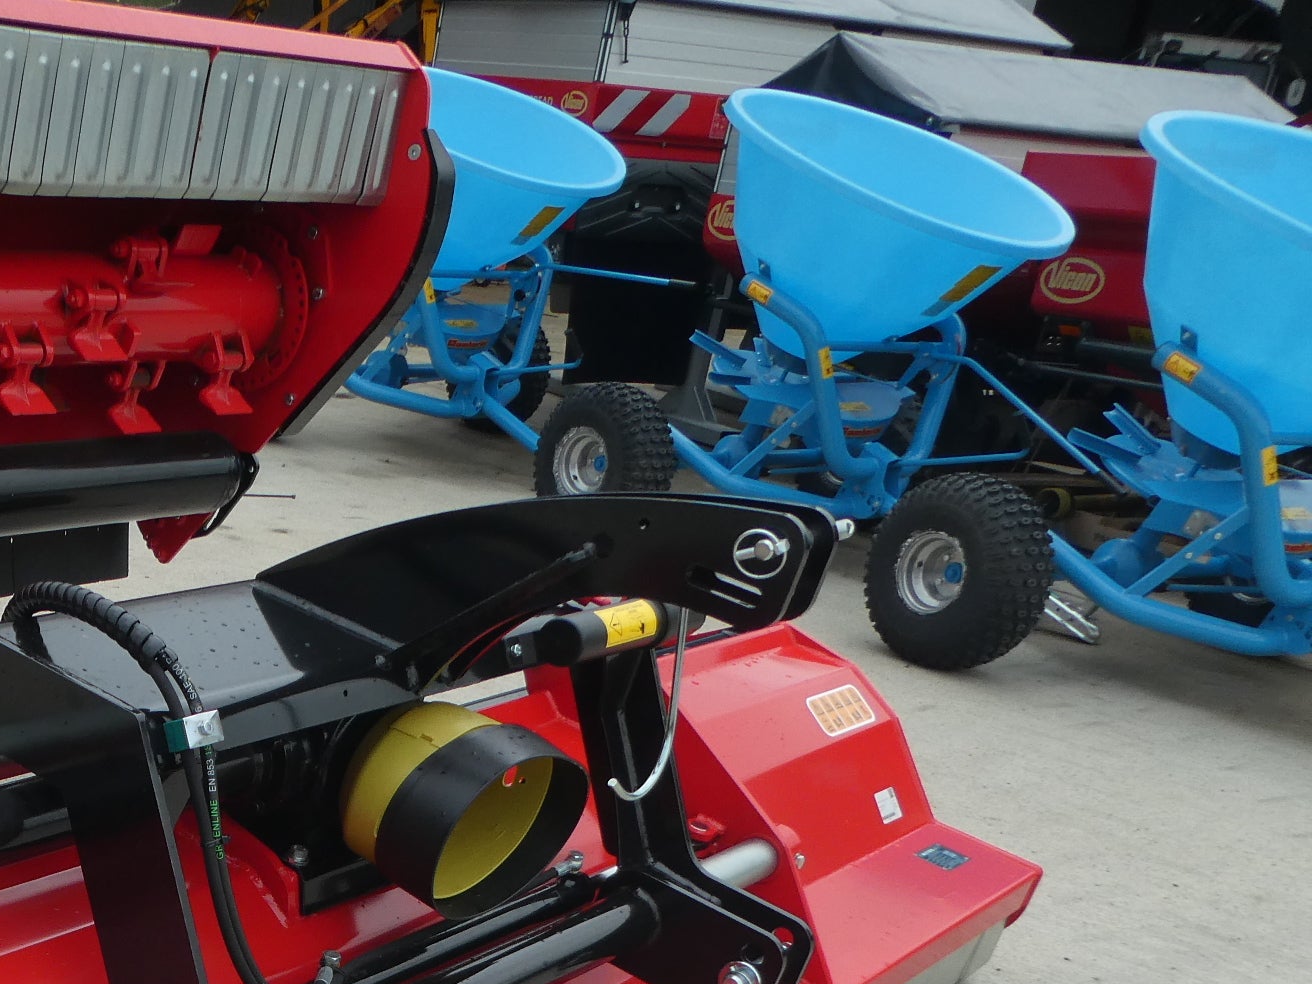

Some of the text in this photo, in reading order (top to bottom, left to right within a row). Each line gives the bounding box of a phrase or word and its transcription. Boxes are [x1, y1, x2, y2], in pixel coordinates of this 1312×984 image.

[1046, 258, 1099, 293] Vicon
[171, 663, 187, 680] 100
[183, 680, 197, 700] SAE
[206, 758, 215, 776] 853
[208, 778, 217, 792] EN
[209, 799, 225, 860] GRENLINE
